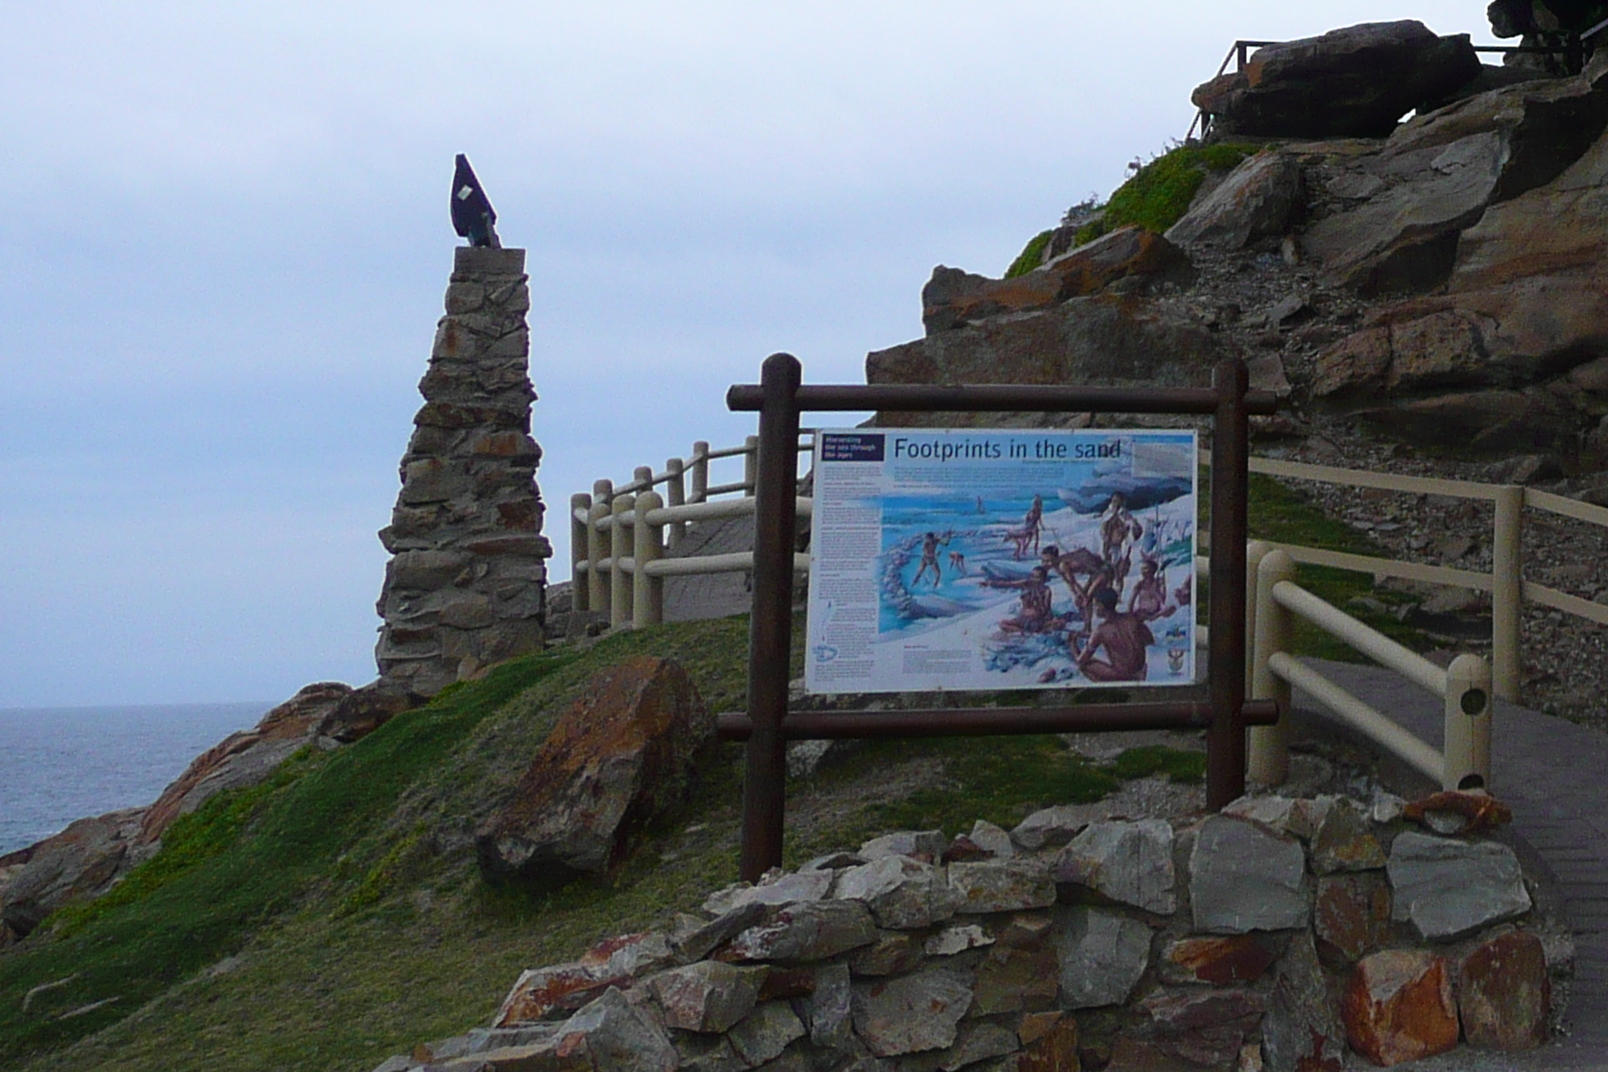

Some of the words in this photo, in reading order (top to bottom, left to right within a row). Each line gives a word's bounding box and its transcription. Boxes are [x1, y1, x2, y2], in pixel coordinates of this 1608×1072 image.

[895, 438, 1001, 462] Footprints
[1010, 438, 1027, 459] in
[1036, 439, 1067, 459] the
[1075, 438, 1121, 459] sand
